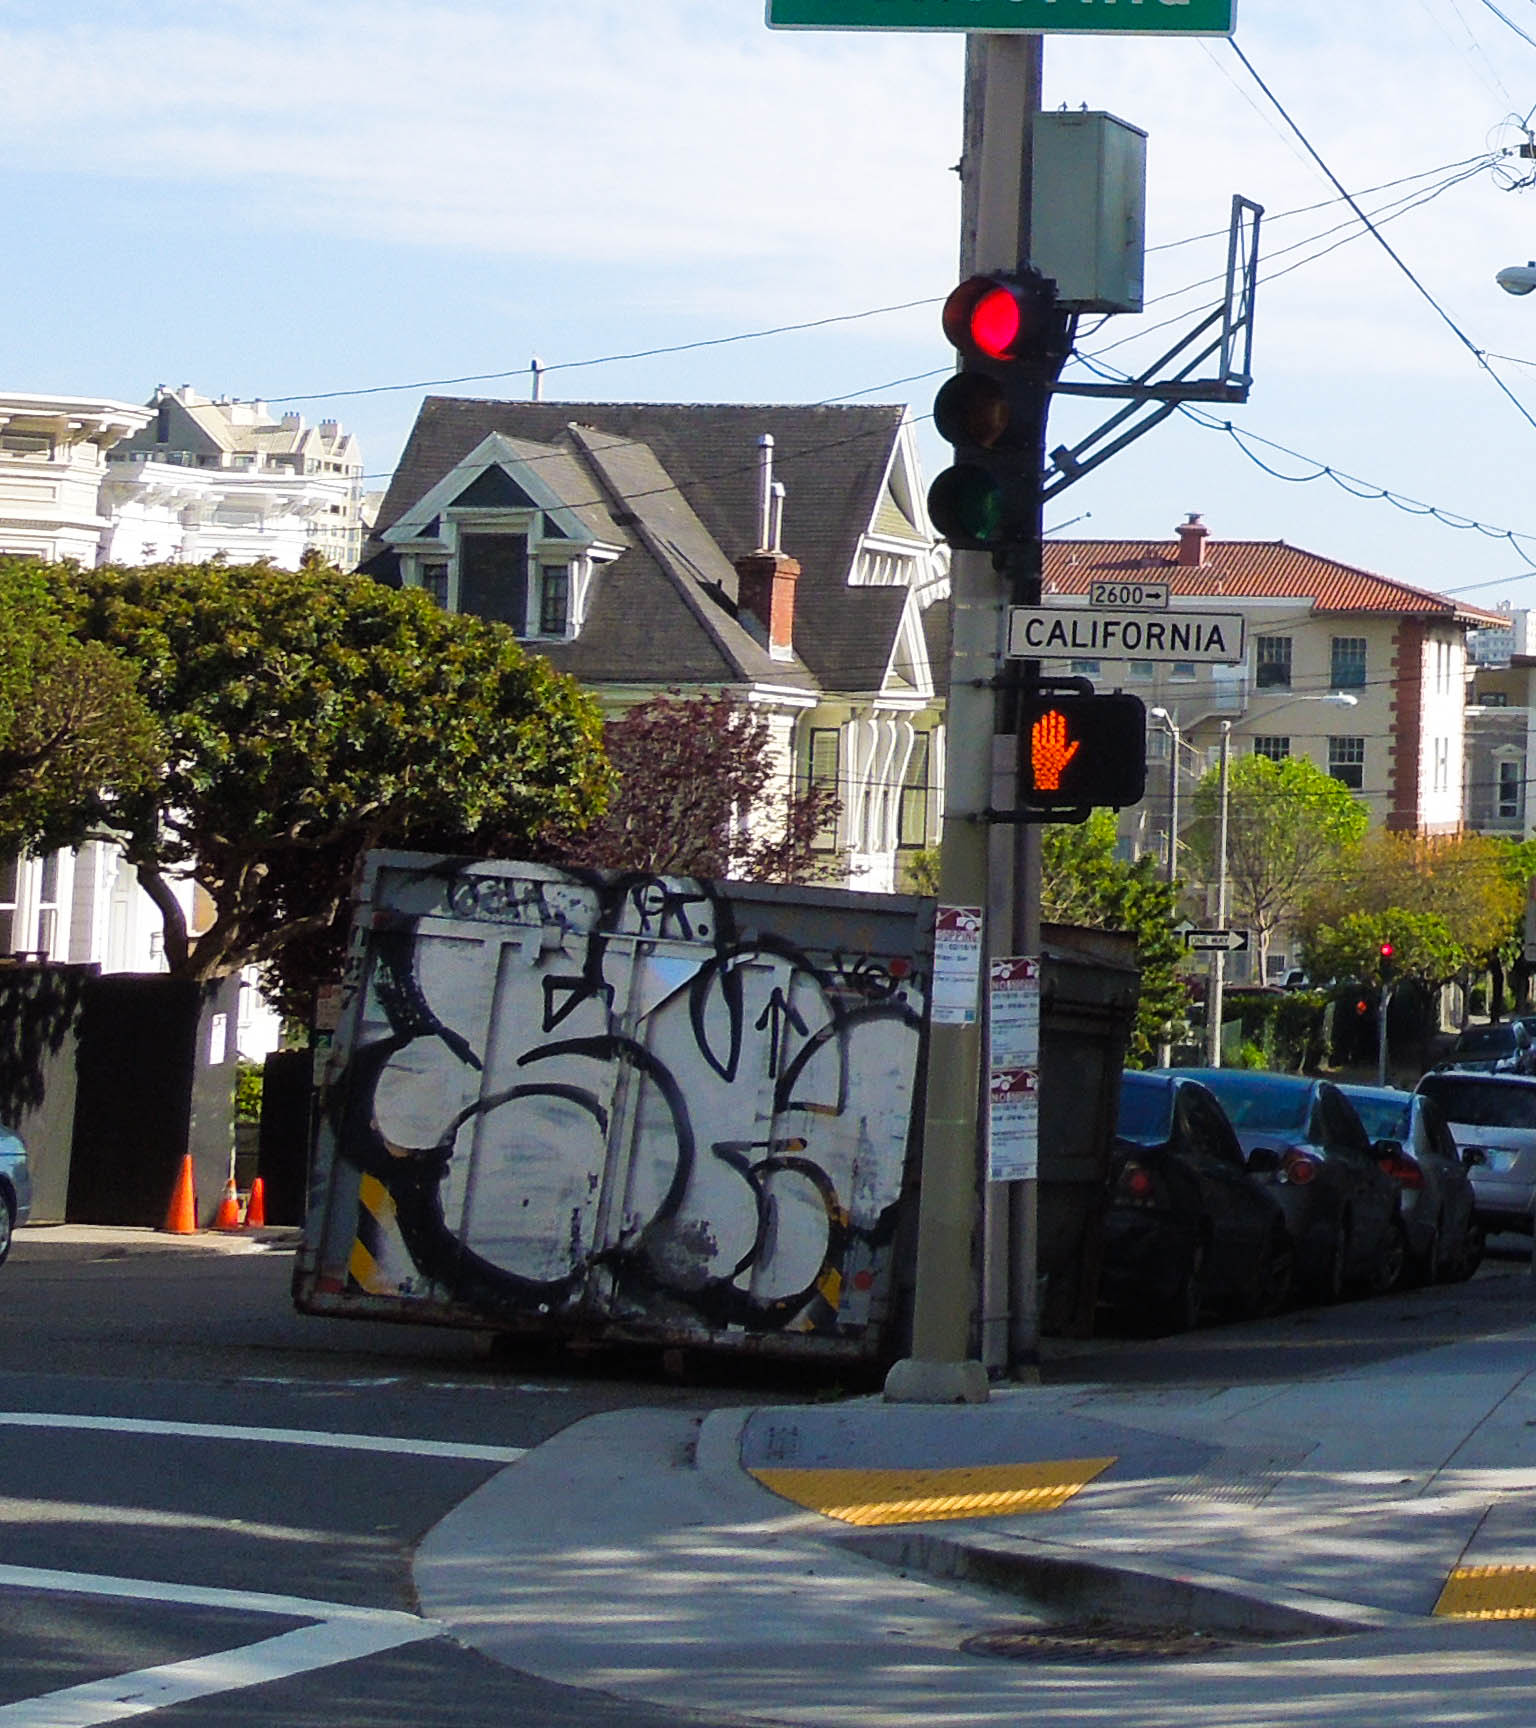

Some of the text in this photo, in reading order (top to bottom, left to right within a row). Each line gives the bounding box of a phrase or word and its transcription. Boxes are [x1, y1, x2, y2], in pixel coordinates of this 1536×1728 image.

[1095, 585, 1143, 604] 2600
[1025, 617, 1226, 653] CALIFORNIA
[1191, 935, 1229, 945] ONE WAY
